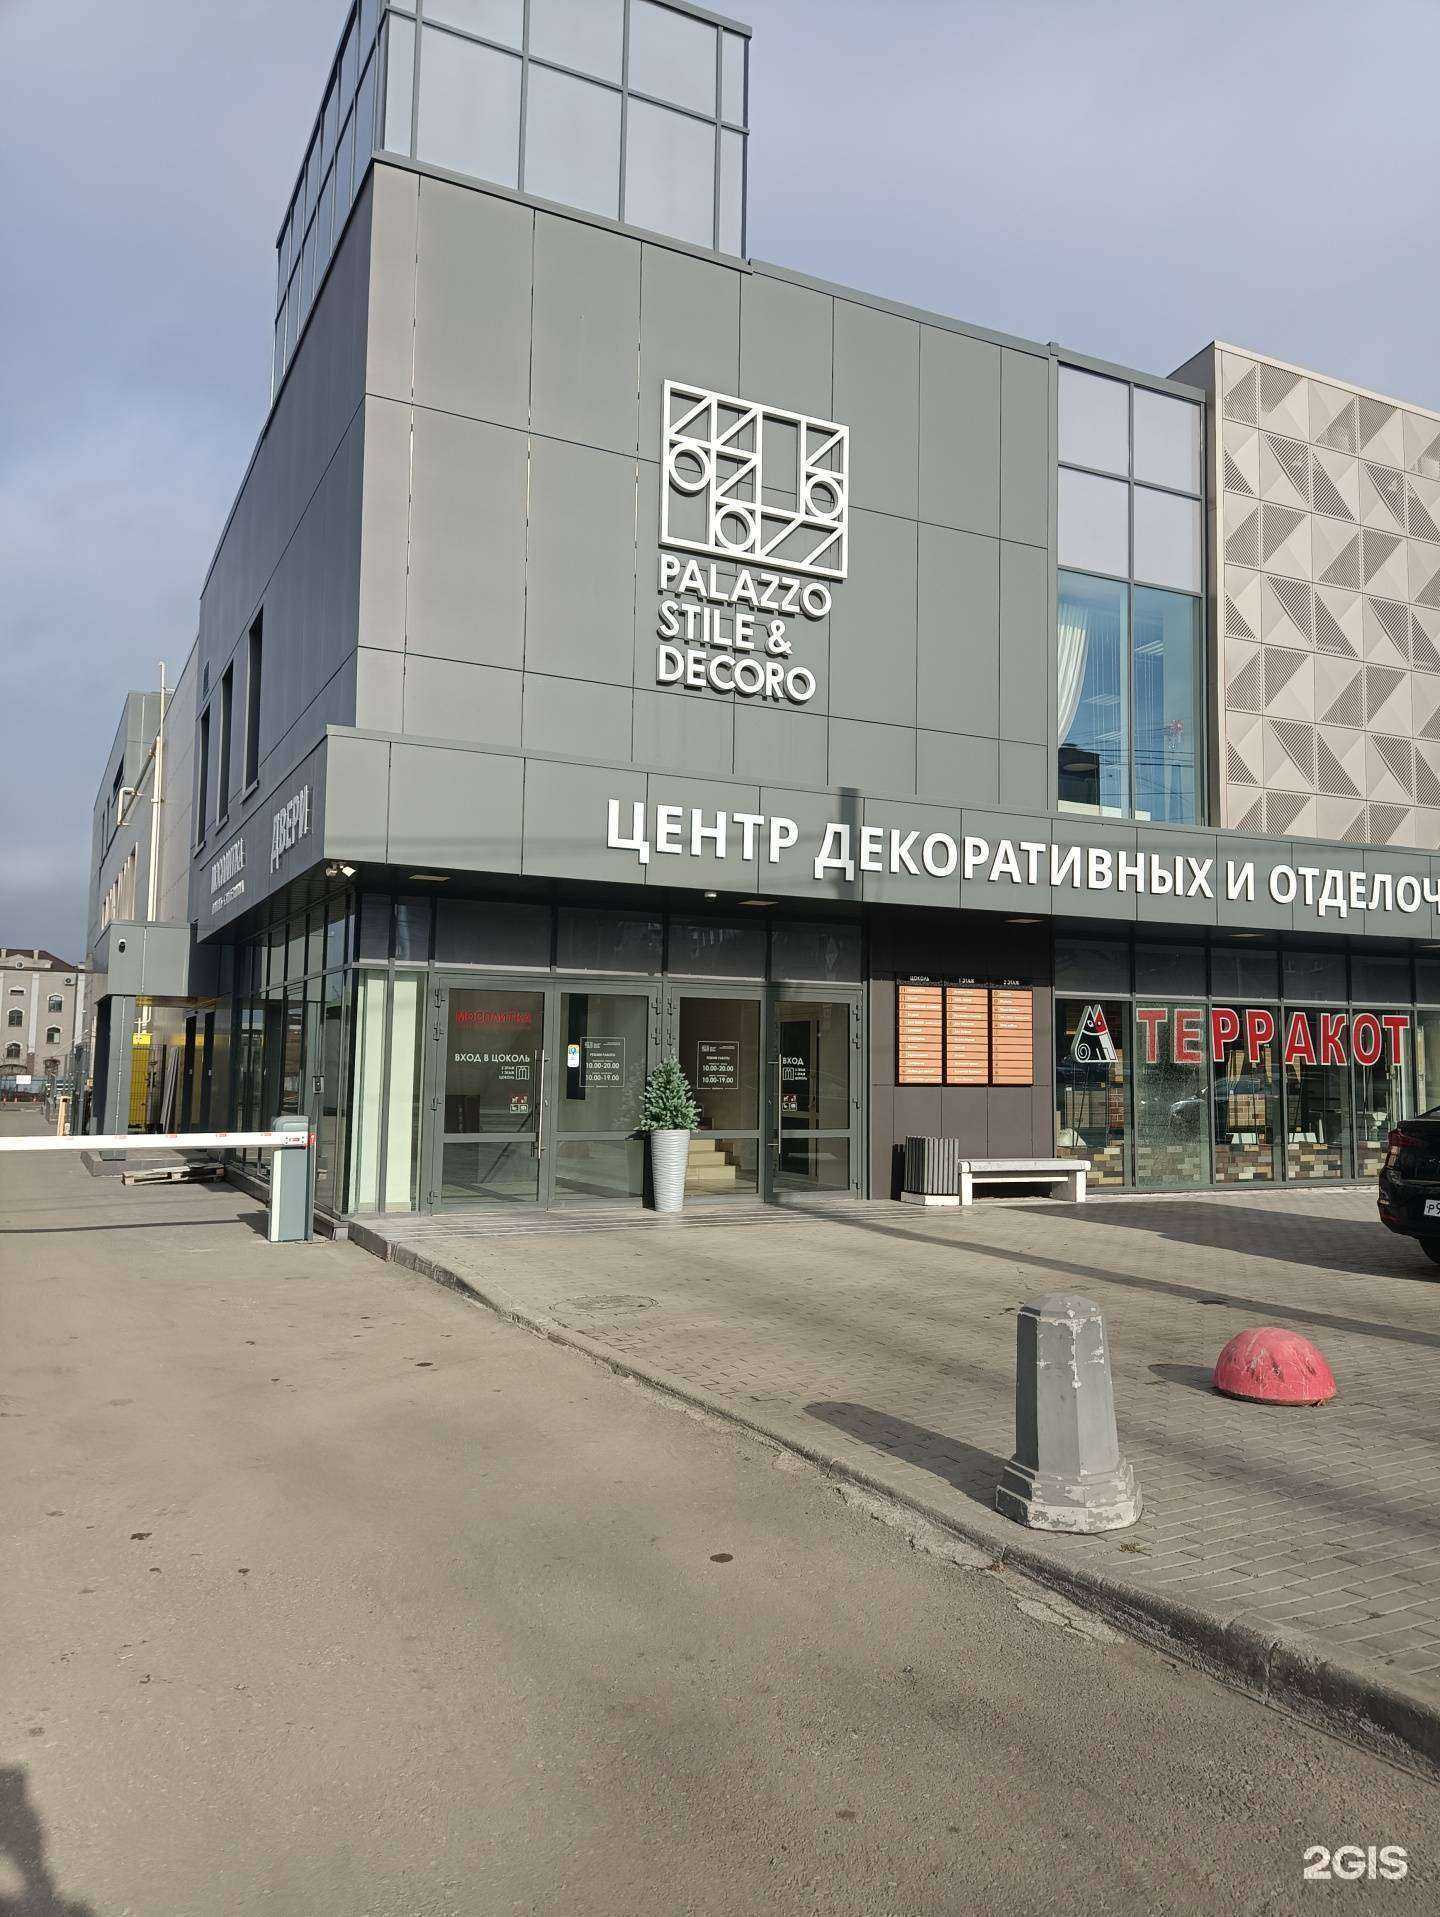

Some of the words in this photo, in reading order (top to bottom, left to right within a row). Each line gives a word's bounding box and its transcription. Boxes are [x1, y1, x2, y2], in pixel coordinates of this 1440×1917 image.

[660, 554, 832, 617] PALAZZO
[658, 600, 754, 650] STILE
[766, 620, 792, 655] &
[658, 645, 816, 701] DECORO
[270, 785, 308, 874] ДВЕРИ
[608, 799, 799, 864] ЦЕНТР
[814, 823, 1214, 898] ДЕКОРАТИВНЫХ
[1227, 860, 1255, 901] И
[455, 1053, 481, 1062] ВХОД
[492, 1054, 530, 1063] ЦОКОЛЬ
[782, 1057, 804, 1065] ВХОД
[1136, 1007, 1410, 1066] ТЕРРАКОТ
